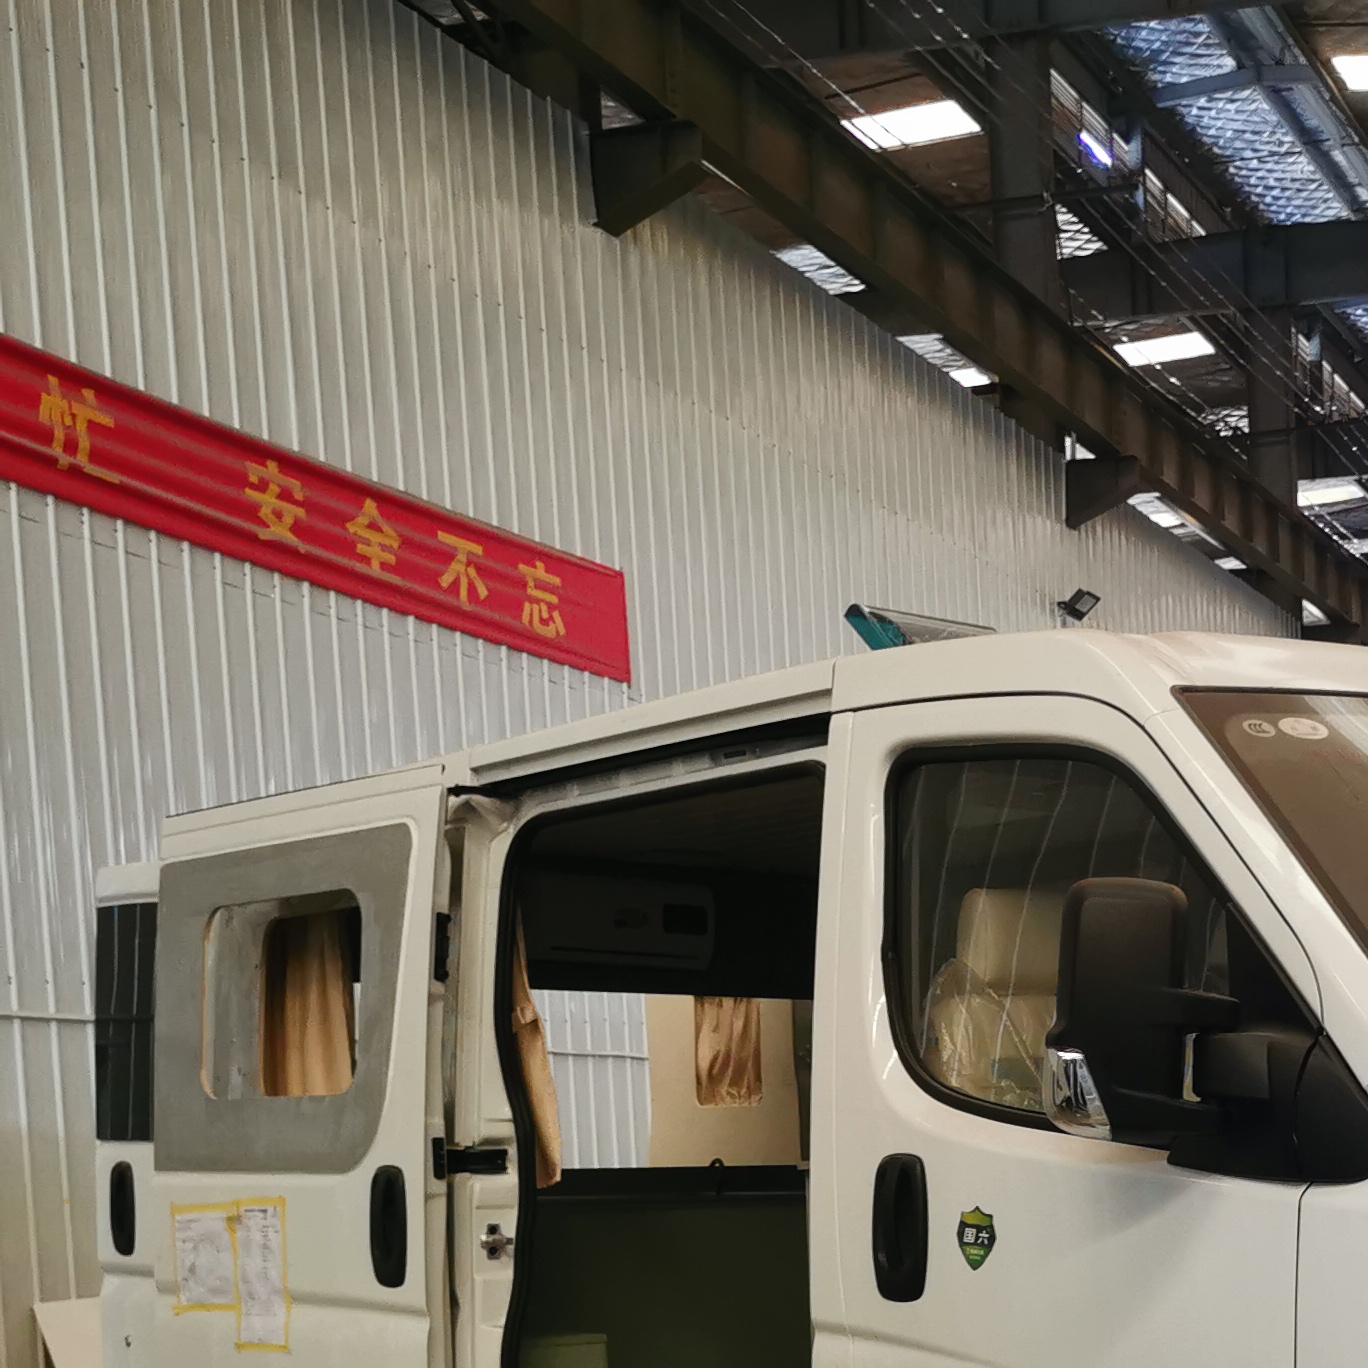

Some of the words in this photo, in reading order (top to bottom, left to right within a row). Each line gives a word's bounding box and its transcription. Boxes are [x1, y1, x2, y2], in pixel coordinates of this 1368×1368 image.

[39, 373, 120, 485] 忙
[243, 459, 566, 638] 安全不忘
[963, 1227, 990, 1245] 国六
